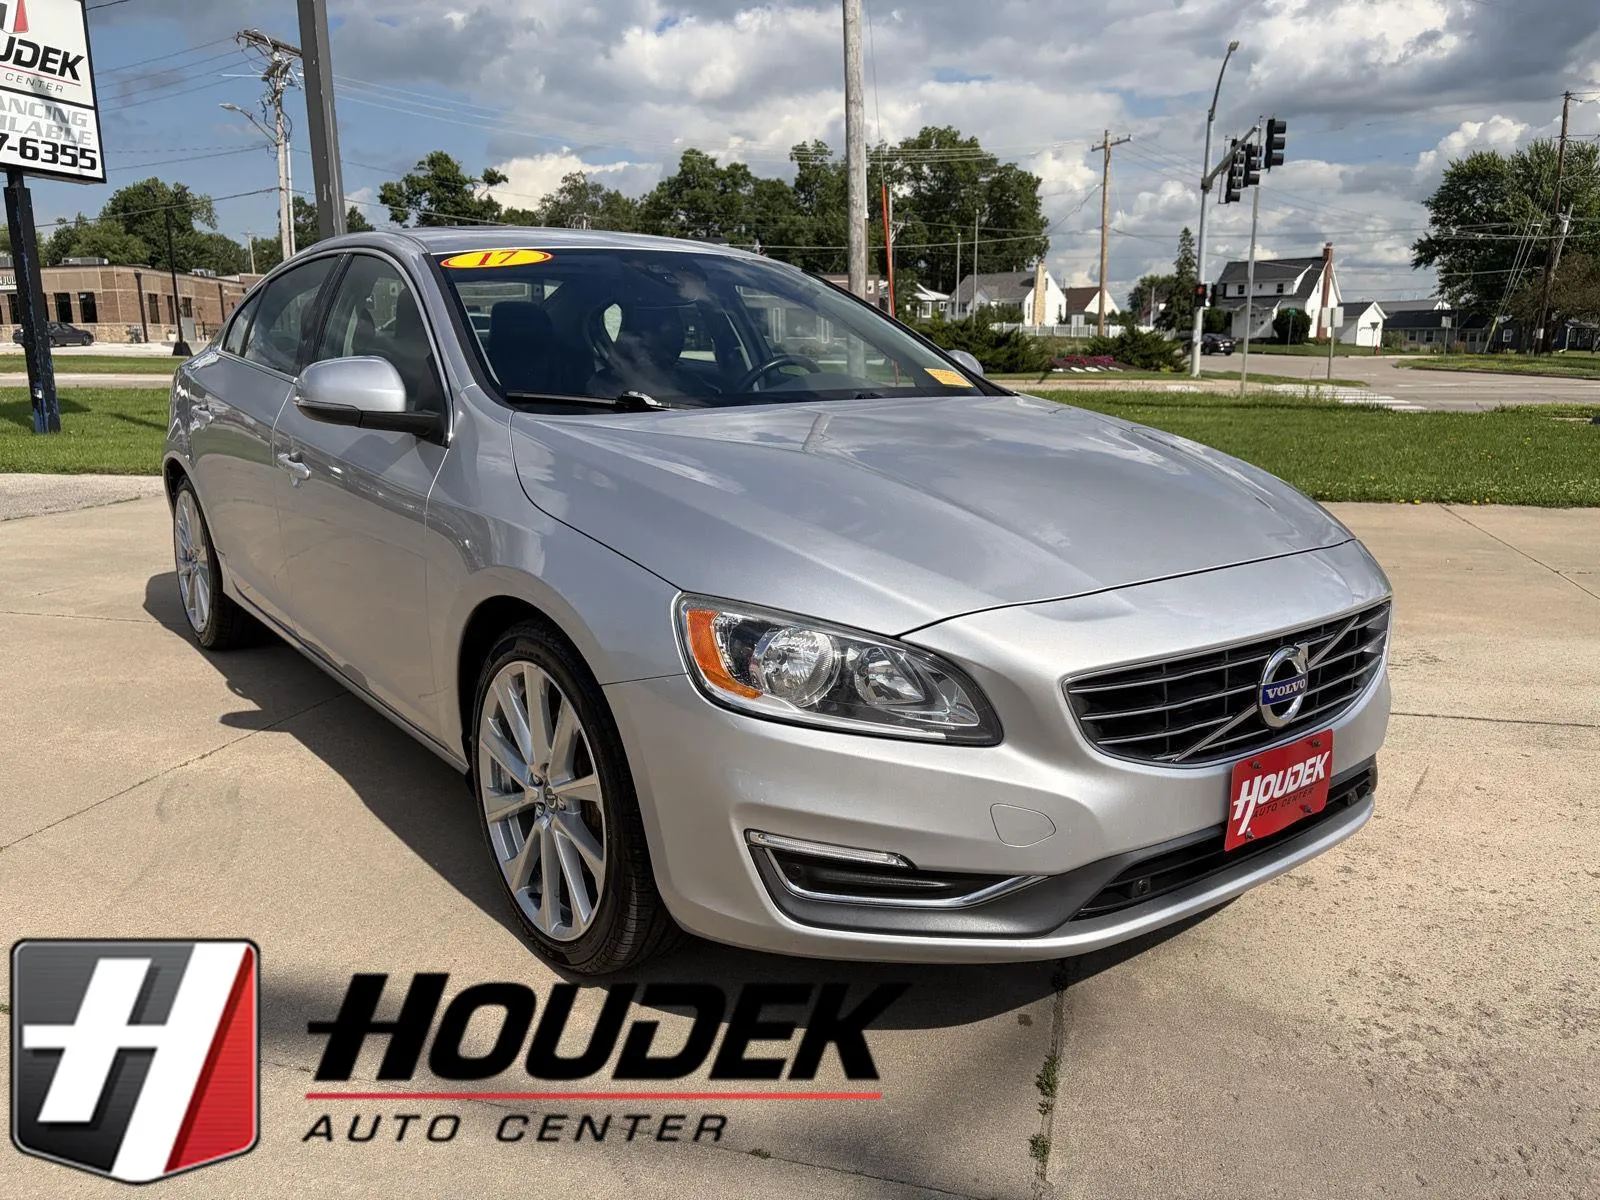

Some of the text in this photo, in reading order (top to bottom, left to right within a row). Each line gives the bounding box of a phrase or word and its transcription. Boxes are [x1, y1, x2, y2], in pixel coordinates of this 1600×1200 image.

[5, 72, 64, 93] CENTER
[478, 250, 520, 267] 17
[1265, 678, 1306, 699] VOLVO
[1232, 751, 1331, 836] HOUDEK
[1254, 803, 1278, 819] AUTO
